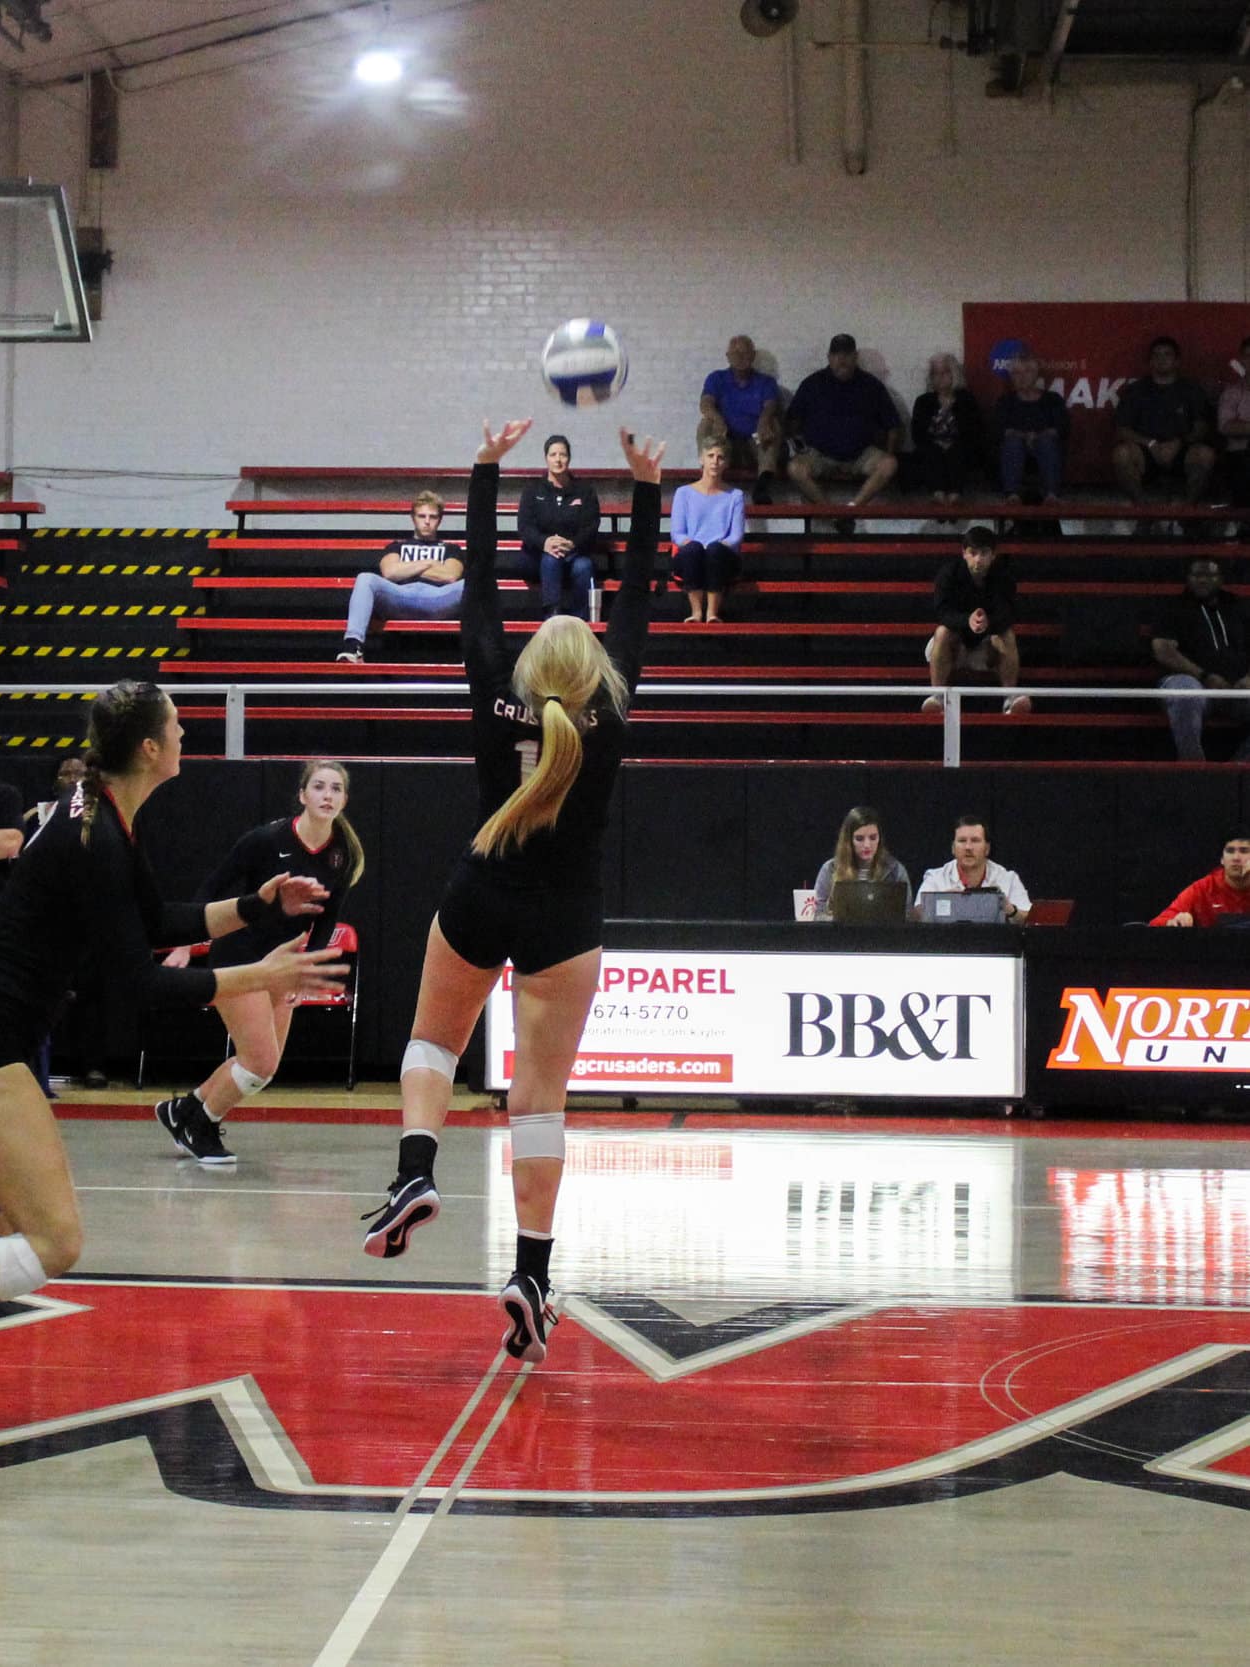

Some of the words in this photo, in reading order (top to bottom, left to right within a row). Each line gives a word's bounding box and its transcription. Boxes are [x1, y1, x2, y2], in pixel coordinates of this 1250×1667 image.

[596, 967, 735, 994] PPAREL
[782, 991, 991, 1062] BB&T
[1055, 994, 1250, 1064] NORT
[571, 1058, 721, 1075] gcrusaders.com
